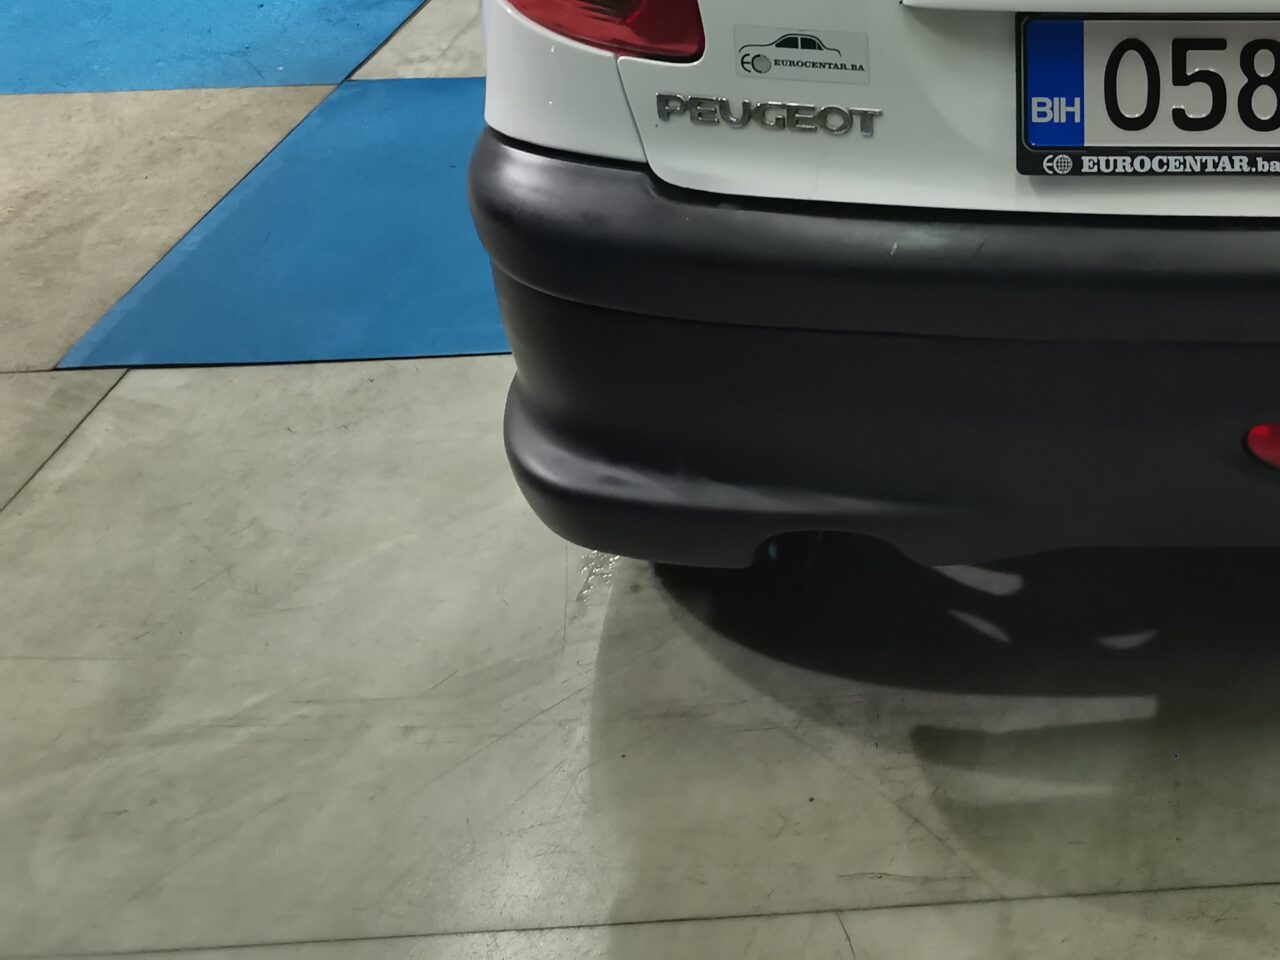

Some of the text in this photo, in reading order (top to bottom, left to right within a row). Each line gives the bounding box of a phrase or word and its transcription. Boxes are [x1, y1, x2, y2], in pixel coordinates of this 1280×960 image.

[773, 58, 865, 72] EUROCENTAR.BA
[656, 92, 883, 138] PEUGEOT
[1030, 97, 1081, 124] BIH
